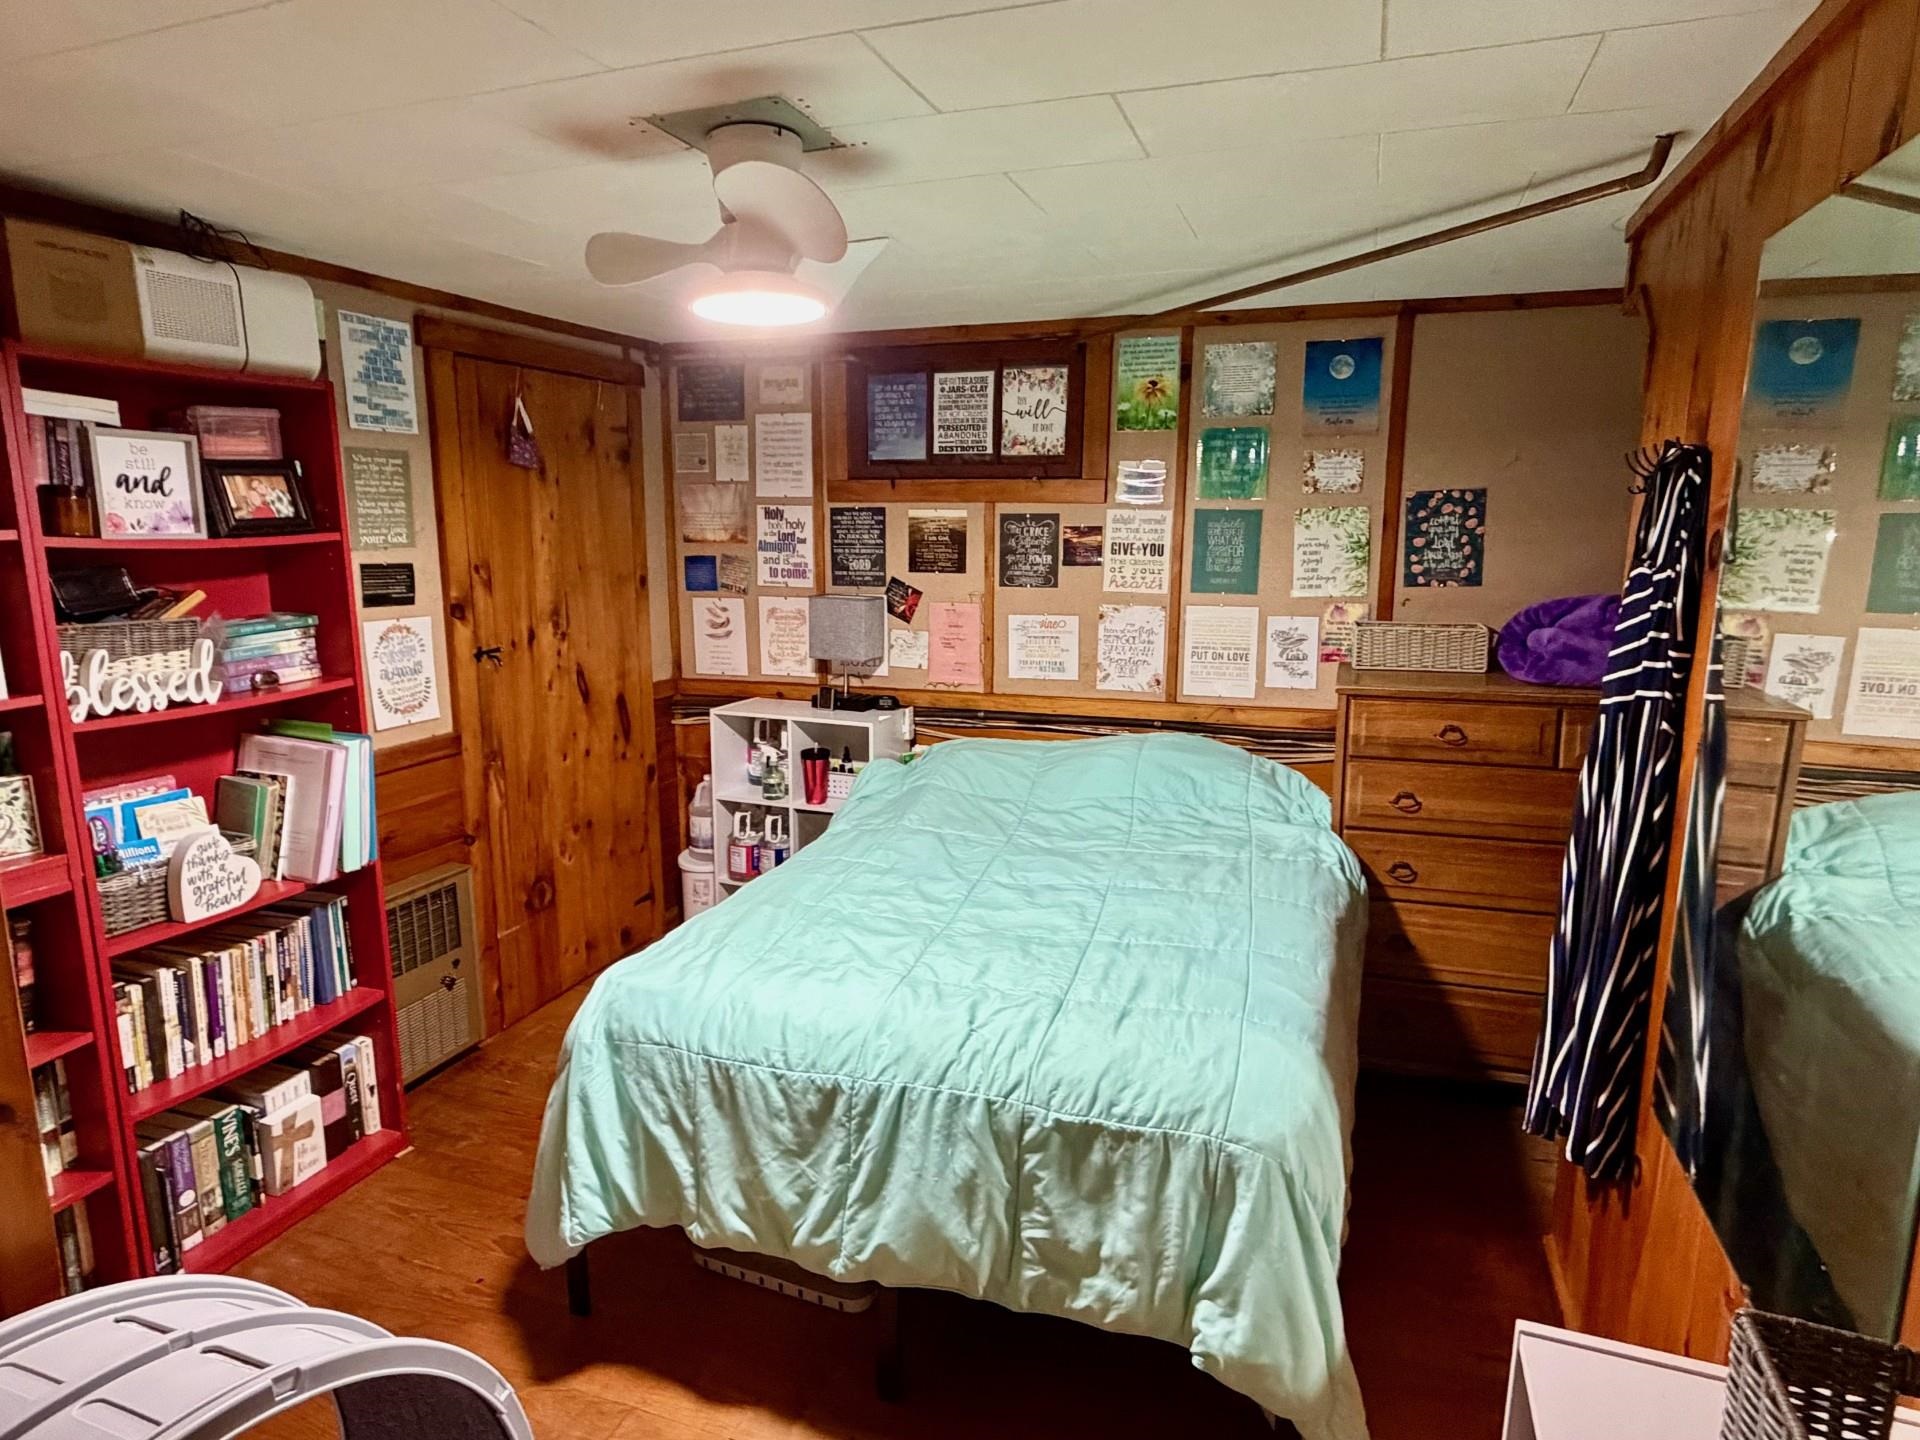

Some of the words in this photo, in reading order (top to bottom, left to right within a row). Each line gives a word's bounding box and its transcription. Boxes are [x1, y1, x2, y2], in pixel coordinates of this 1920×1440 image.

[957, 375, 989, 385] TREASURE
[946, 385, 967, 393] JARS
[970, 385, 989, 393] CLAY
[1010, 398, 1058, 420] will
[938, 423, 982, 431] PERSECUTED
[938, 431, 988, 440] ABANDONED
[128, 441, 149, 456] be
[938, 445, 988, 453] DESTROYED
[125, 458, 156, 471] still
[116, 466, 174, 498] and
[125, 499, 166, 511] know
[777, 530, 796, 543] Lord
[1142, 527, 1166, 535] LORD
[1110, 541, 1136, 556] GIVE
[1141, 542, 1165, 558] YOU
[763, 555, 781, 566] and
[1110, 557, 1126, 566] the
[769, 567, 779, 579] to
[1109, 565, 1125, 574] of
[1131, 567, 1165, 576] your
[1108, 574, 1159, 590] heart
[1191, 650, 1209, 661] PUT
[1211, 651, 1225, 661] ON
[1227, 651, 1251, 662] LOVE
[60, 638, 223, 724] blessed
[186, 849, 230, 873] thanks
[187, 865, 214, 887] with
[219, 863, 228, 873] a
[192, 866, 248, 907] grateful
[200, 884, 245, 912] heart
